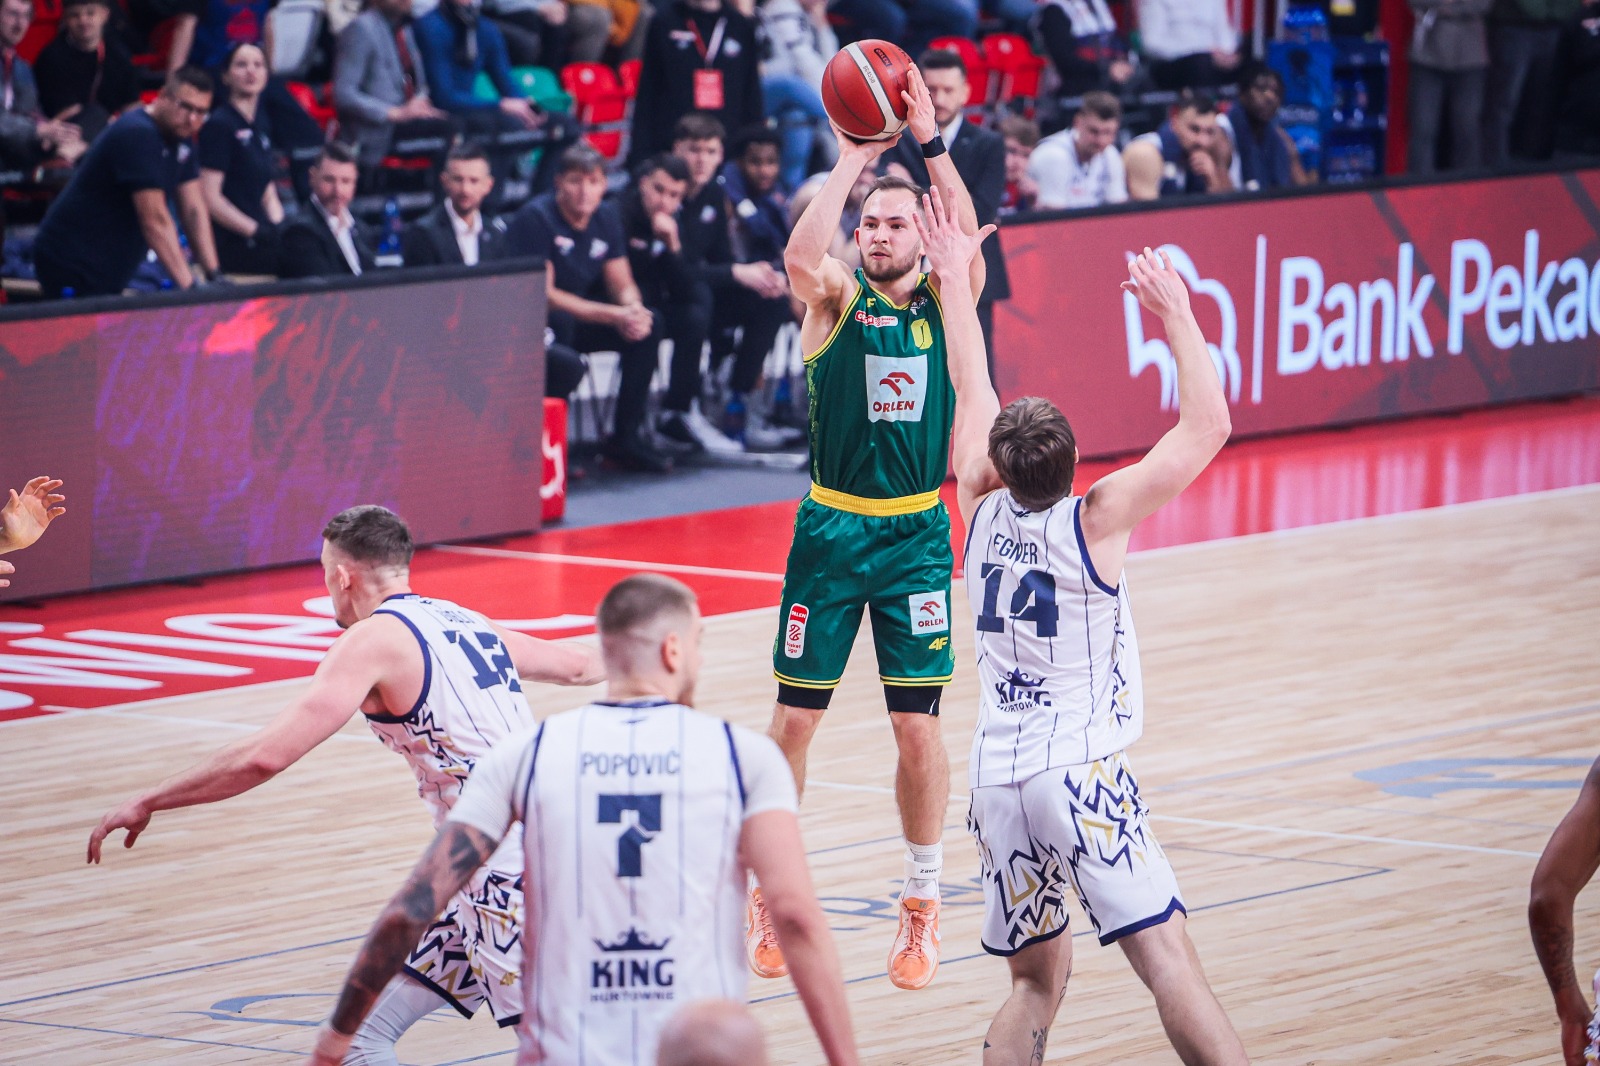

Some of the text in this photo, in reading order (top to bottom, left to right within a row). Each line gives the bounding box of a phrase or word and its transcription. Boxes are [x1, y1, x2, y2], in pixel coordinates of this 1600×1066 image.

[1277, 229, 1600, 376] Bank Peka
[911, 318, 934, 350] 0
[873, 401, 915, 412] ORLEN
[993, 532, 1038, 564] EGNER
[977, 562, 1059, 637] 14
[918, 618, 944, 627] ORLEN
[929, 636, 949, 651] 4F
[580, 747, 681, 775] POPOVIĆ
[598, 794, 662, 877] 7
[592, 959, 674, 988] KING
